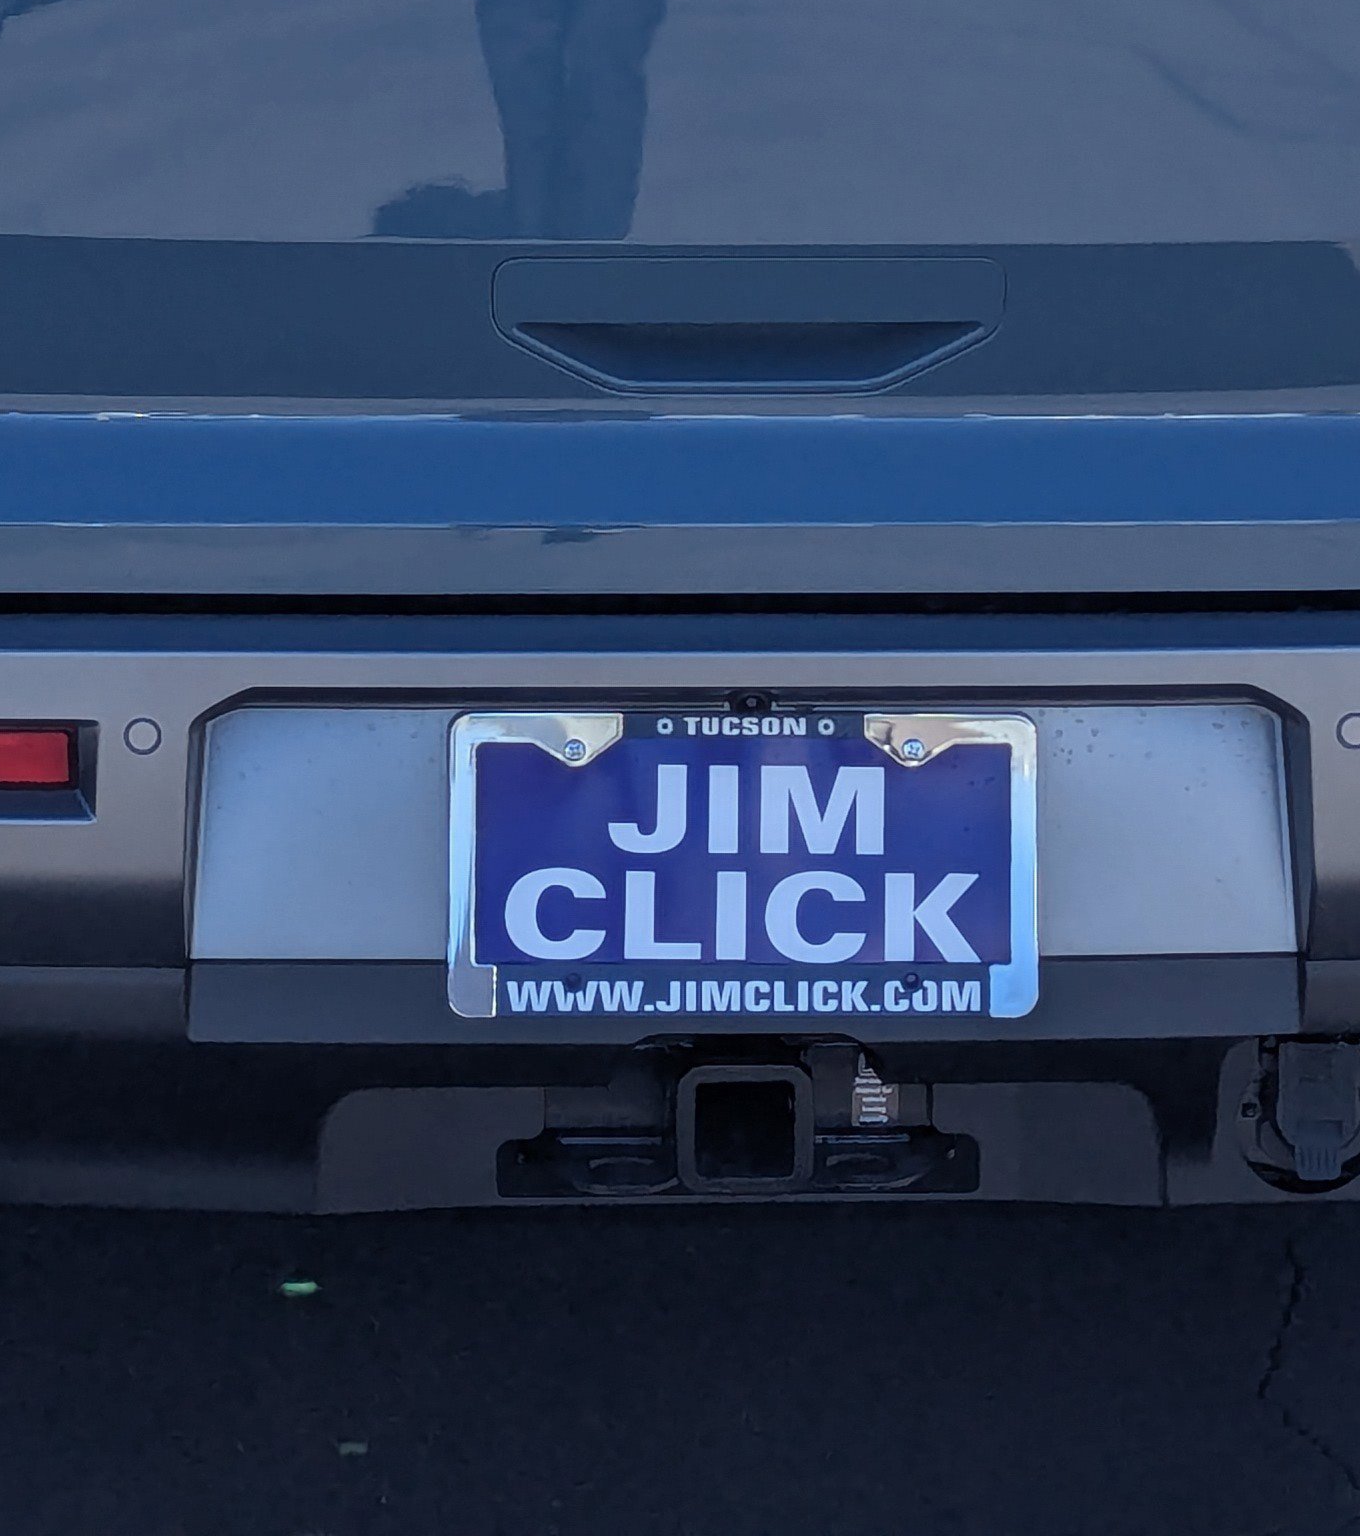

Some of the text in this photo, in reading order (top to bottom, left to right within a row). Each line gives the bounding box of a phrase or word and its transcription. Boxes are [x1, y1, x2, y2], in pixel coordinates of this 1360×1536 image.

[682, 716, 808, 736] TUCSON
[607, 764, 886, 856] JIM
[503, 866, 983, 964] CLICK
[506, 979, 983, 1013] WWW.JIMCLICK.COM
